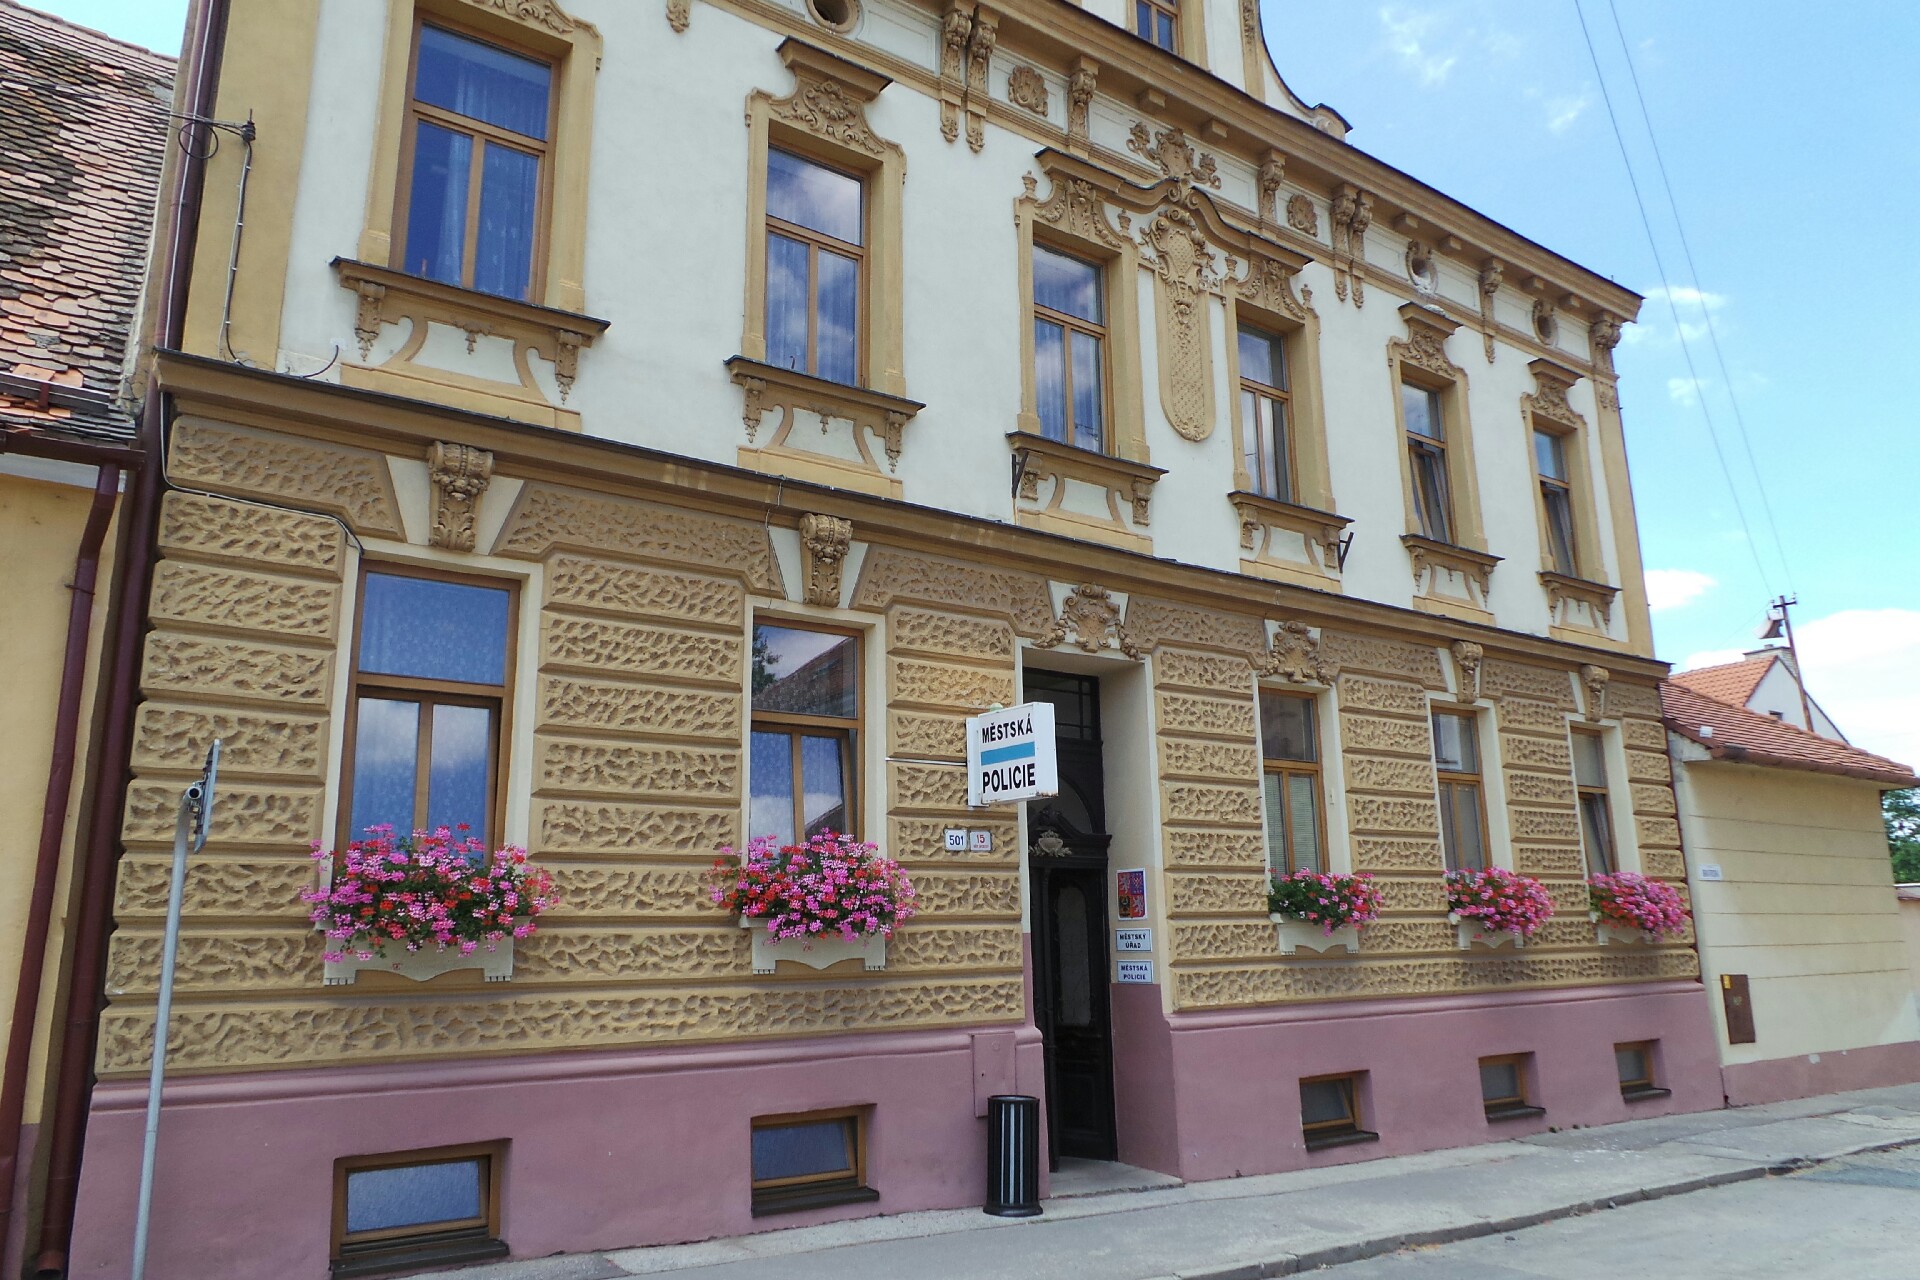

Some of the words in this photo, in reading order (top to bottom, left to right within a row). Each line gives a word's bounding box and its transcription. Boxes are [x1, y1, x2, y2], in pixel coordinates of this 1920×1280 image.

[982, 713, 1033, 743] MĚSTSKÁ
[982, 763, 1036, 793] POLICIE
[949, 835, 964, 846] 501
[976, 834, 986, 844] 15
